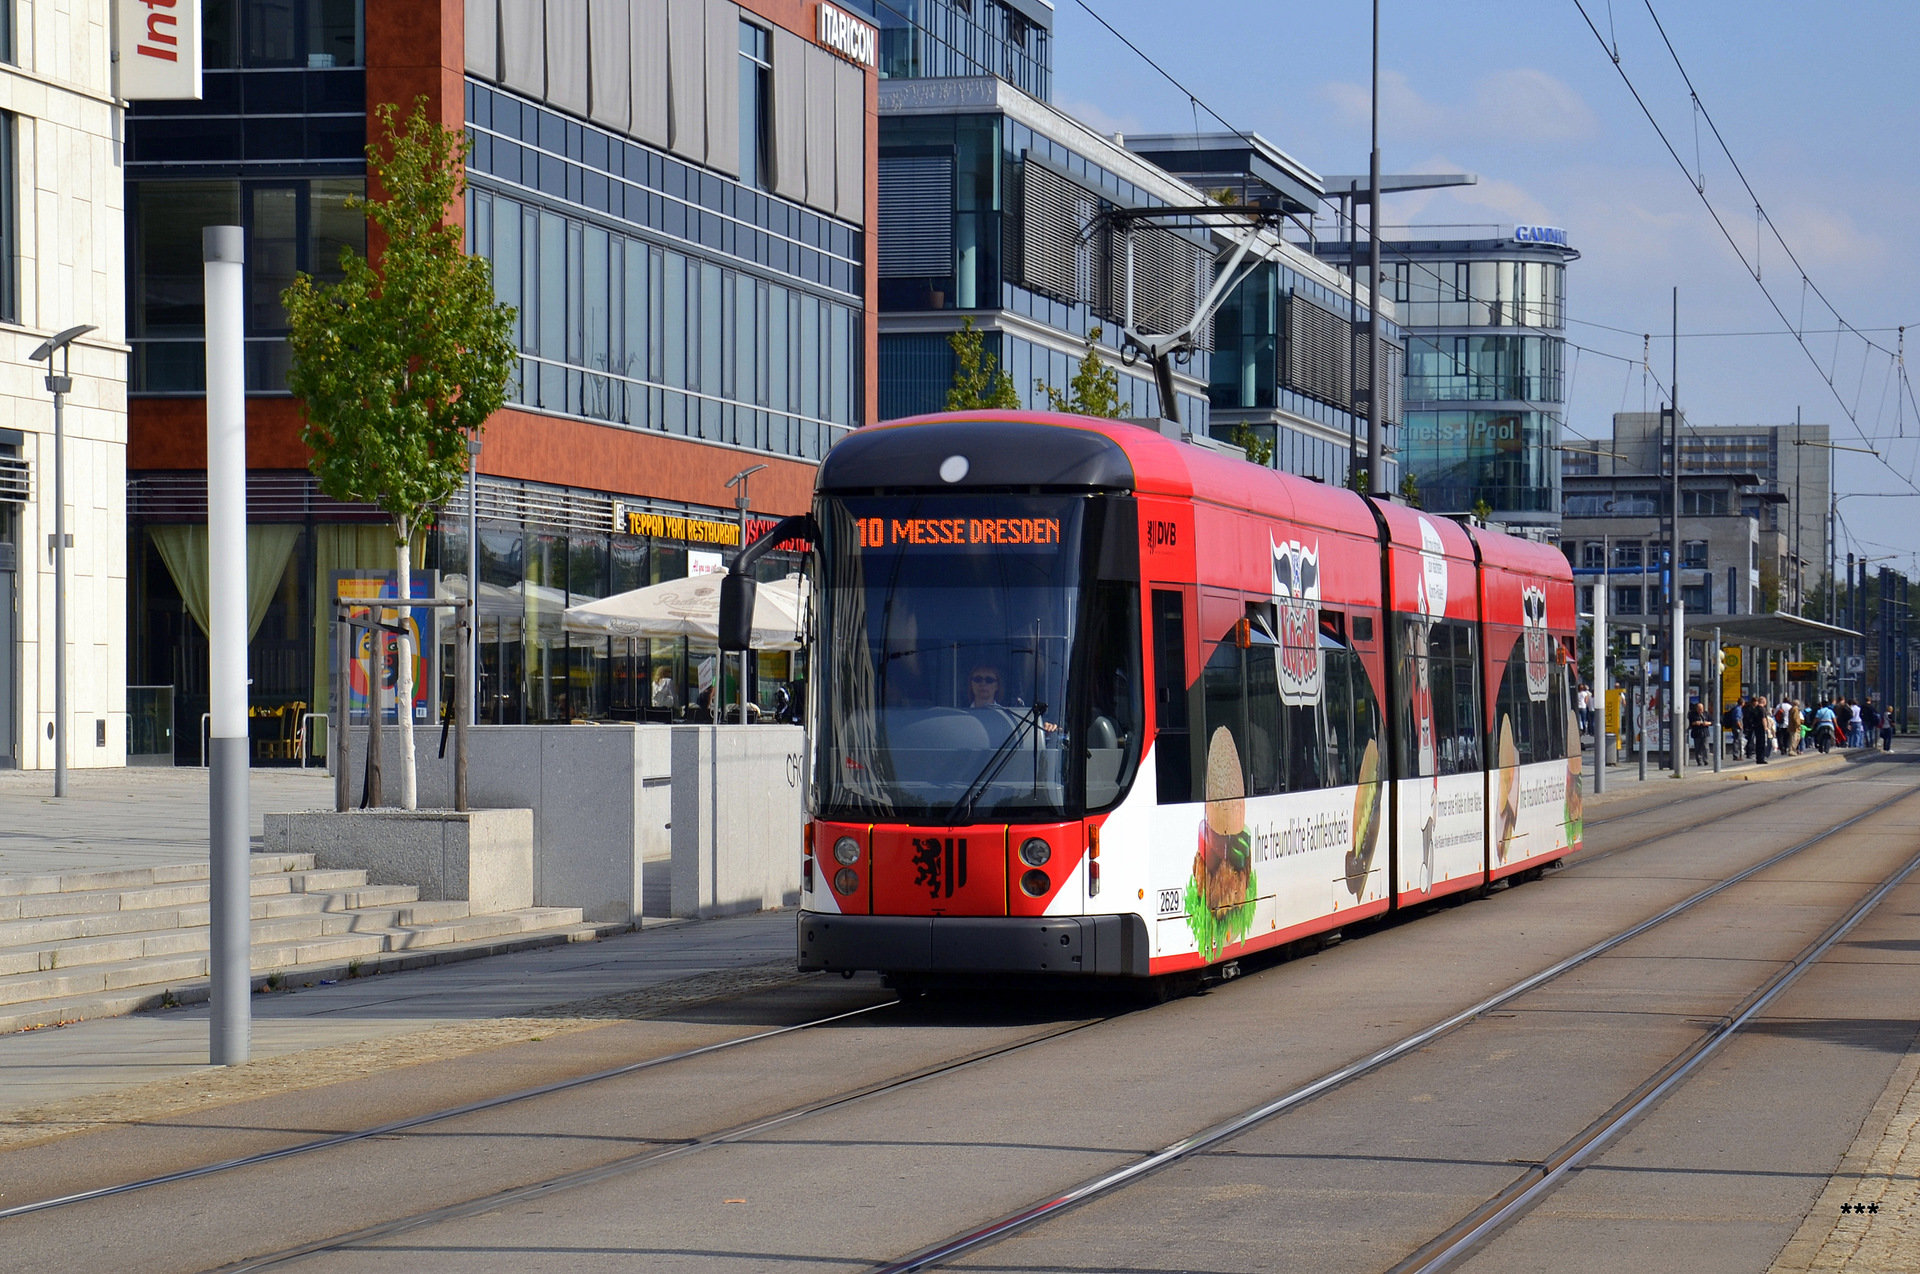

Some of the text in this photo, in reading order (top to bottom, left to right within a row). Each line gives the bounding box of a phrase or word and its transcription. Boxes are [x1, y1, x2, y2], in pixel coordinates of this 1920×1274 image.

[821, 2, 874, 67] ITARICON
[1474, 419, 1515, 440] Pool
[628, 511, 664, 537] TEPPAN
[665, 515, 686, 540] YAKI
[687, 518, 741, 546] RESTAURANT
[856, 517, 1060, 547] 10 MESSE DRESDEN
[1157, 520, 1176, 546] DVB
[1254, 809, 1349, 863] Ihre freundliche Fachfleischerei
[1160, 890, 1179, 912] 2629
